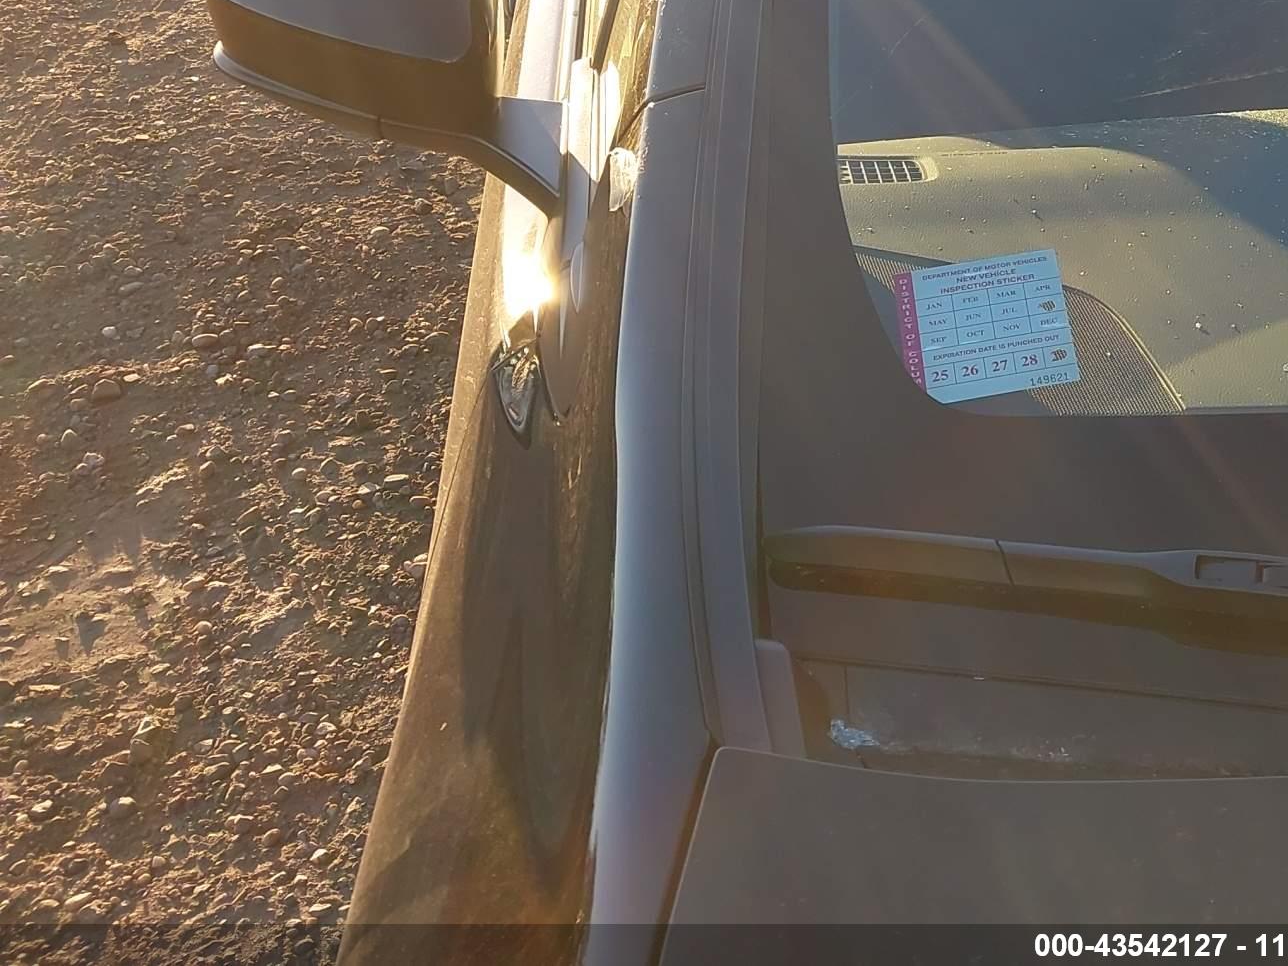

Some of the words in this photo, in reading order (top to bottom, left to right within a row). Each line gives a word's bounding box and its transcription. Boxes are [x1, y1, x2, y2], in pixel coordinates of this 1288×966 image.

[922, 268, 970, 281] DEPARTMENT
[984, 262, 1011, 271] MOTOR
[1012, 256, 1047, 267] VEHICLES
[956, 274, 977, 284] NEW
[979, 268, 1017, 280] VEHICLE
[940, 281, 994, 294] INSPECTION
[996, 273, 1035, 285] STICKER
[926, 302, 942, 311] JAN
[996, 290, 1016, 298] MAR
[928, 318, 948, 327] MAY
[965, 313, 982, 321] JUN
[1001, 307, 1018, 315] JUL
[966, 330, 985, 338] OCT
[1003, 323, 1021, 332] NOV
[1040, 317, 1058, 326] DEC
[933, 348, 977, 361] EXPIRATION
[978, 344, 997, 353] DATE
[998, 342, 1006, 350] IS
[1007, 336, 1043, 348] PUNCHED
[1044, 334, 1060, 343] OUT
[932, 369, 949, 383] 25
[961, 365, 979, 377] 26
[992, 359, 1008, 373] 27
[1021, 353, 1040, 367] 28
[1029, 372, 1069, 387] 149621
